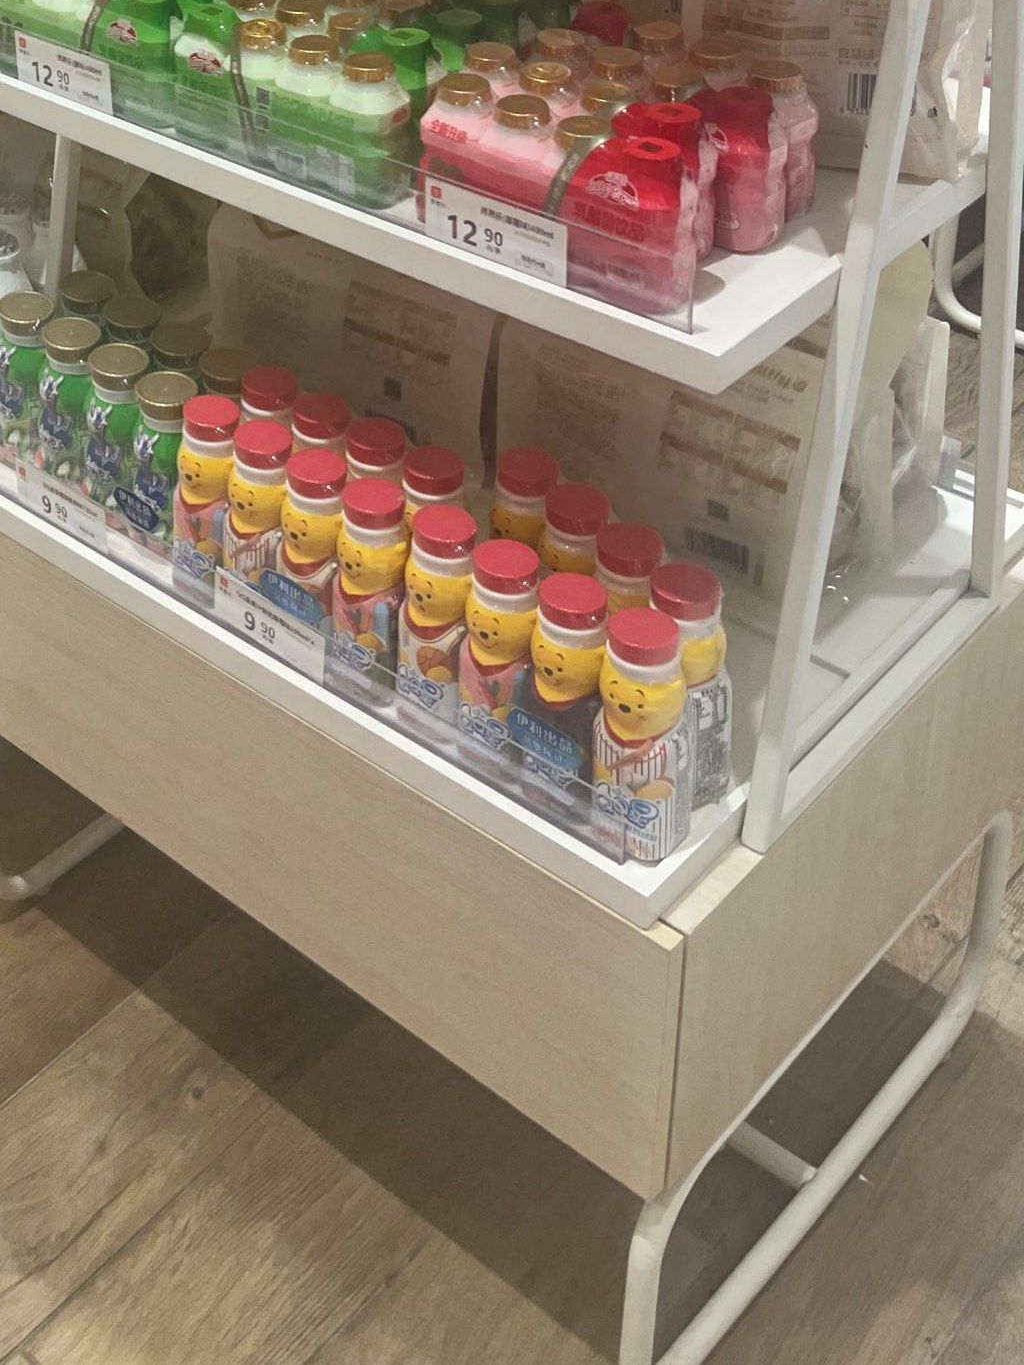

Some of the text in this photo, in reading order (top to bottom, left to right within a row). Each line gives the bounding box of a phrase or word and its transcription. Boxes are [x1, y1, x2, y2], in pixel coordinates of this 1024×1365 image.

[31, 61, 54, 88] 12
[57, 69, 70, 85] 90
[447, 213, 478, 248] 12
[484, 227, 504, 247] 90
[42, 494, 53, 514] 9
[55, 502, 68, 518] 90
[243, 610, 275, 640] 9 90
[516, 711, 573, 755] 伊利出品
